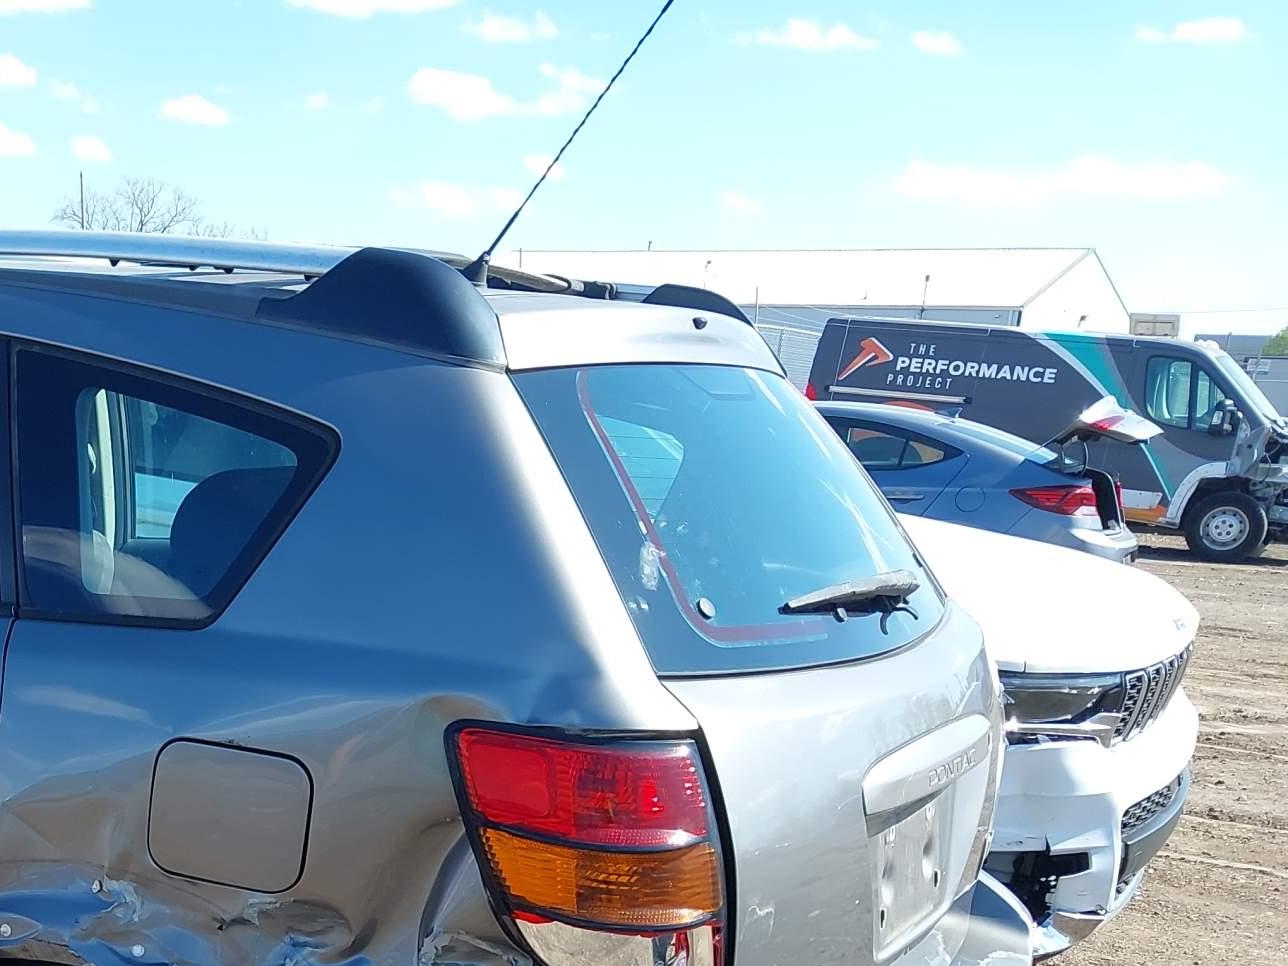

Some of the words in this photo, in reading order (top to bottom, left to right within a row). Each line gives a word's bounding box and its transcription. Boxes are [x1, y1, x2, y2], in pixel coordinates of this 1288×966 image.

[910, 343, 937, 356] THE
[895, 355, 1058, 384] PERFORMANCE
[886, 374, 953, 390] PROJECT
[928, 749, 977, 790] PONTIAC
